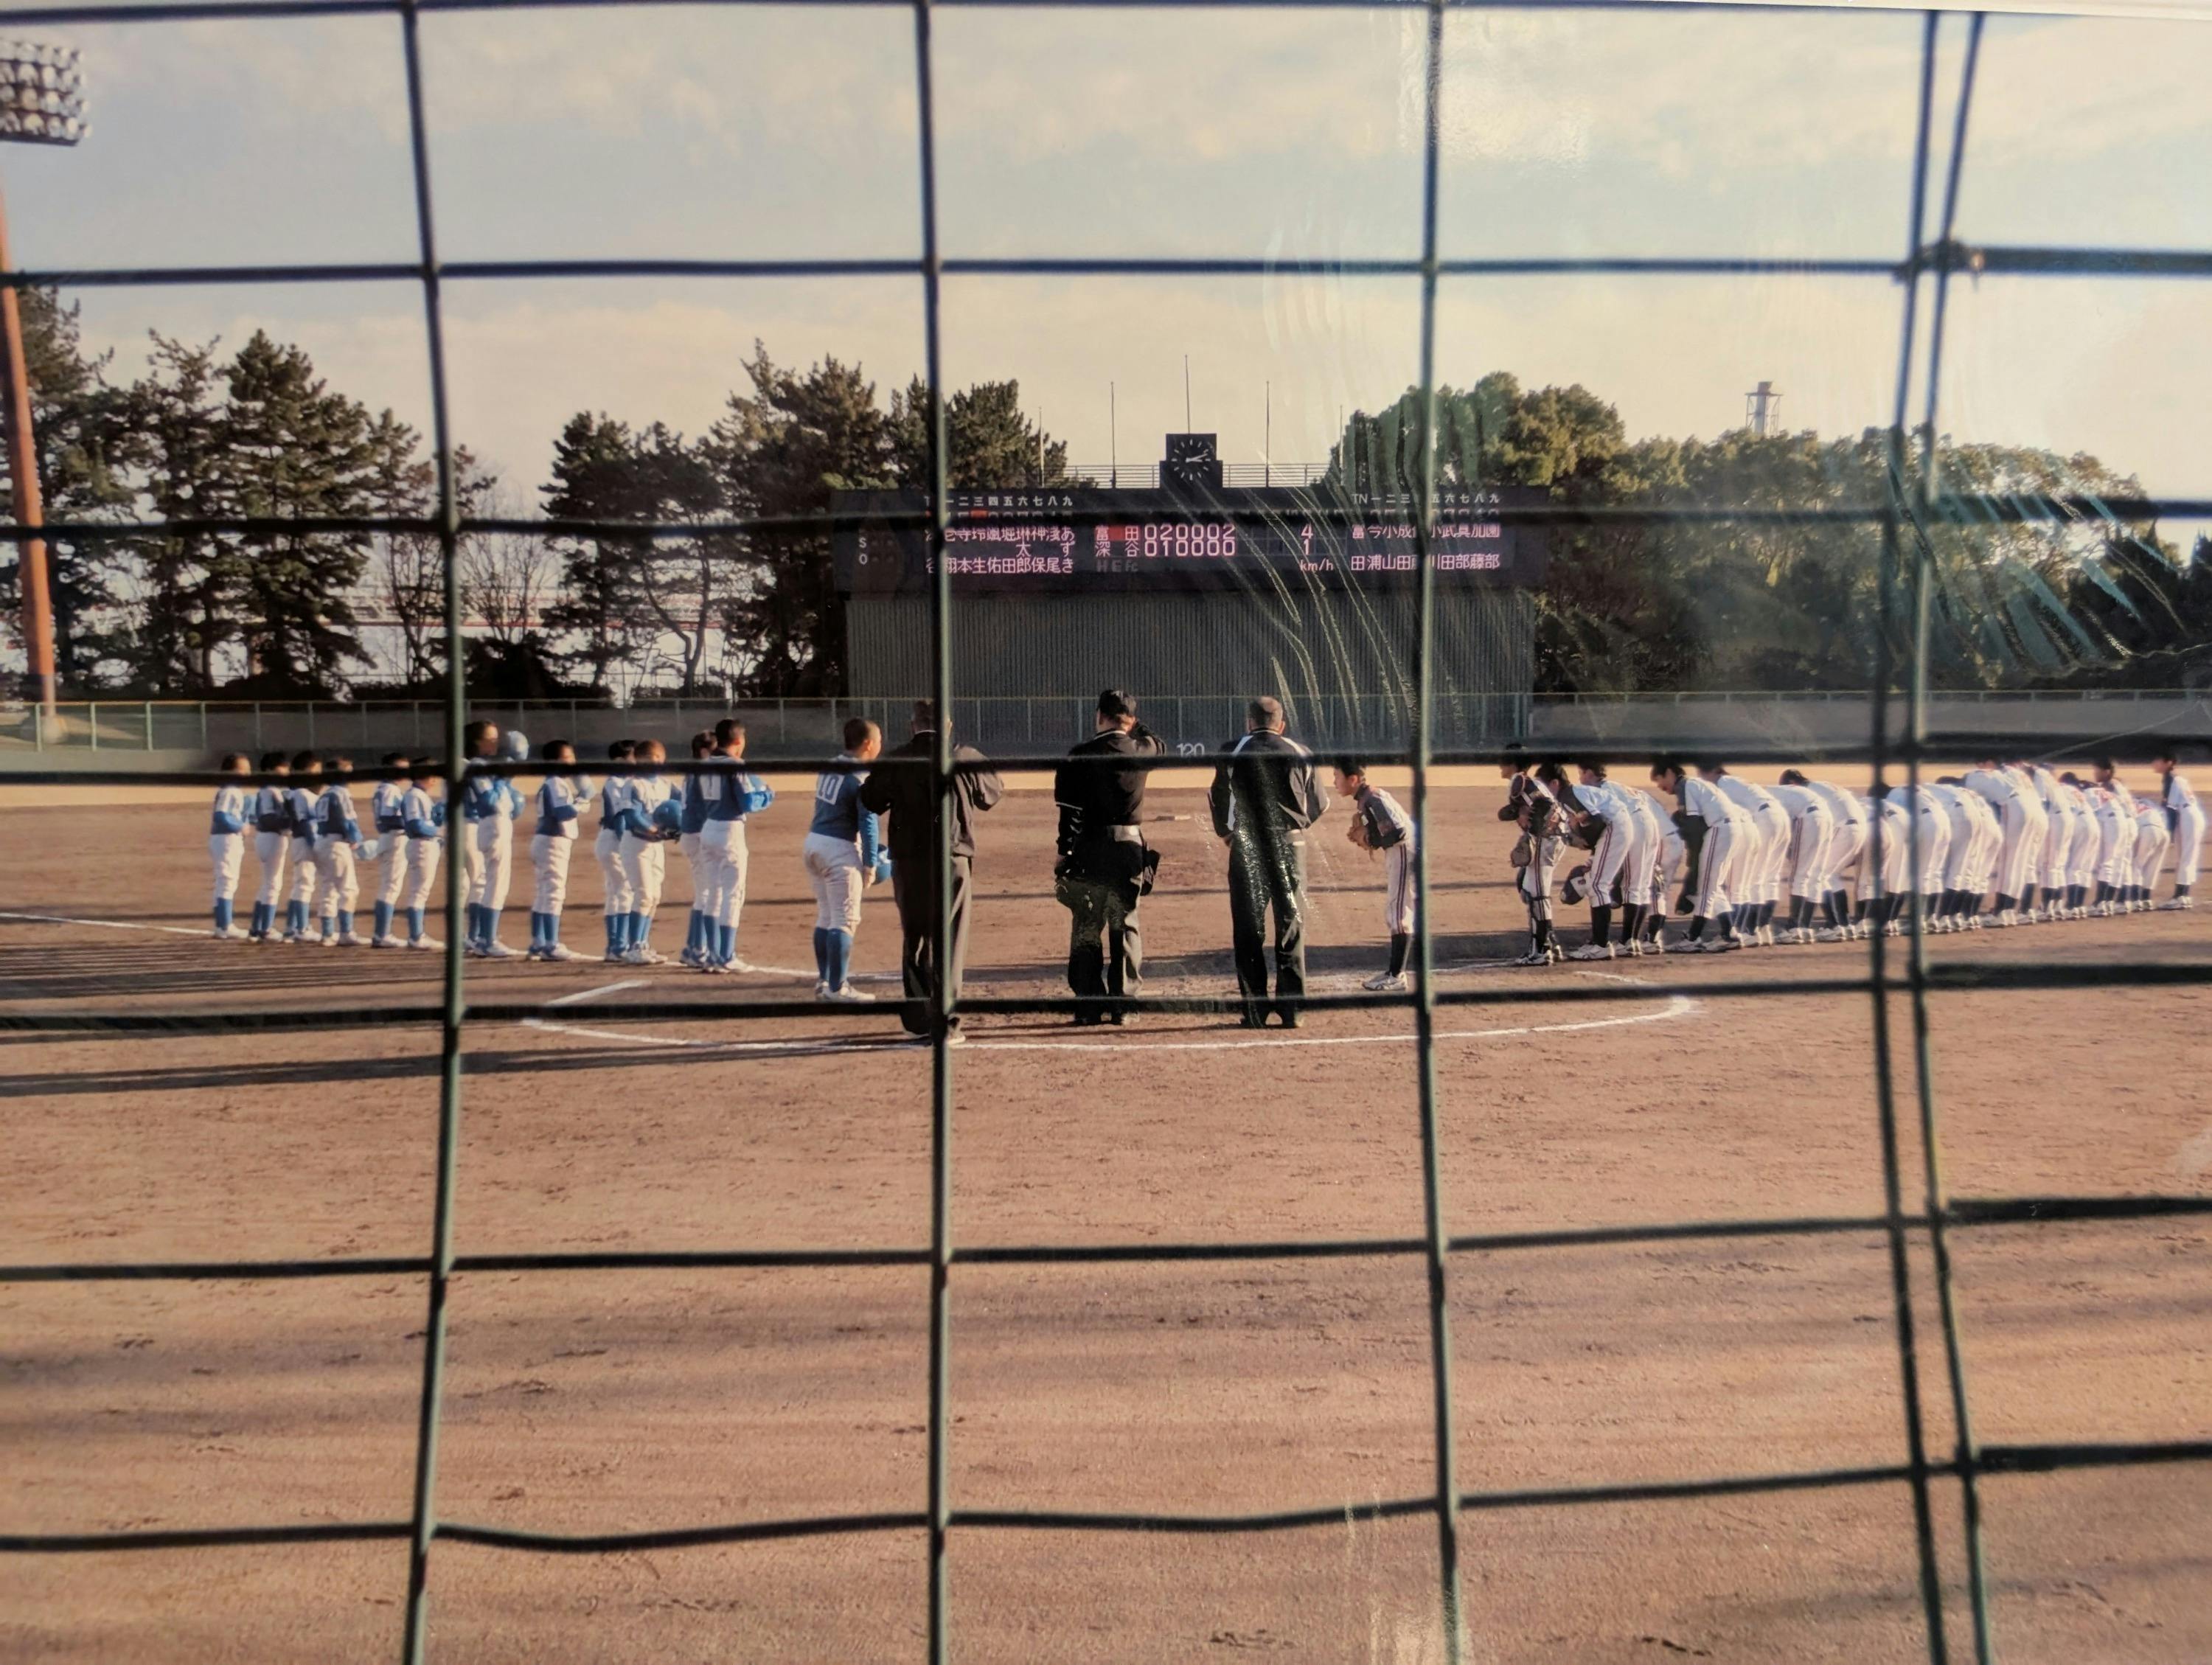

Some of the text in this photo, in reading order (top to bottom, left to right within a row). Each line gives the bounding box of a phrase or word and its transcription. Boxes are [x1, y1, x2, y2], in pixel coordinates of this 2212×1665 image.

[1144, 523, 1236, 540] 020002
[859, 537, 867, 548] S
[1144, 540, 1236, 557] 010000
[1300, 557, 1334, 571] km/h
[1177, 743, 1205, 757] 120
[818, 774, 839, 800] 10
